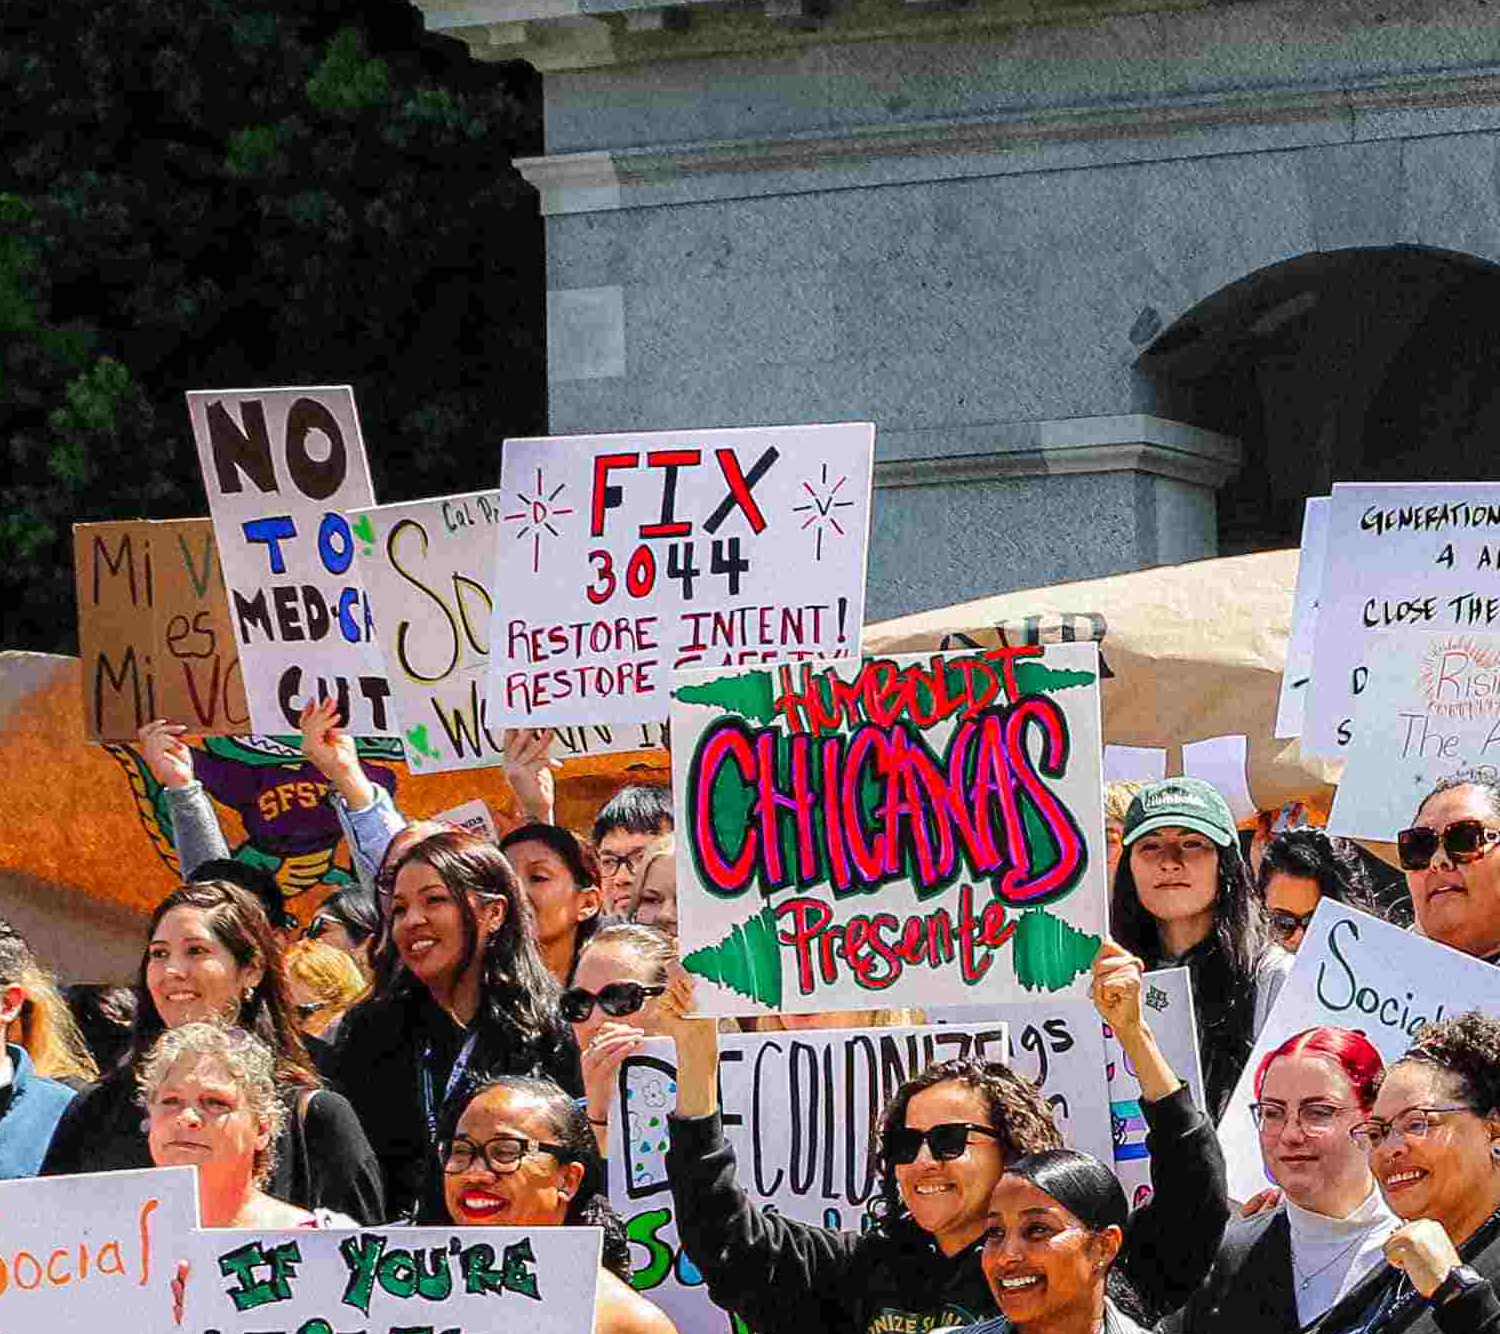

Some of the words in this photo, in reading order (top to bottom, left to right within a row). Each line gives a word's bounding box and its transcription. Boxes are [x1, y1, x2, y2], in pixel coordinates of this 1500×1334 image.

[204, 398, 348, 500] NO
[591, 445, 779, 538] FIX
[93, 535, 154, 607] Mi
[241, 511, 355, 575] TO
[587, 537, 749, 604] 3044
[1436, 544, 1453, 569] 4
[165, 611, 217, 659] es
[507, 616, 658, 663] RESTORE
[678, 597, 847, 652] INTENT!
[1364, 596, 1436, 627] CLOSE
[1449, 592, 1499, 624] THE
[94, 644, 156, 729] Mi
[277, 664, 390, 731] CUT
[506, 660, 657, 714] RESTORE
[774, 646, 1043, 736] HUMBOLDT
[1400, 713, 1459, 758] The
[688, 695, 1088, 908] CHICANAS
[776, 884, 1016, 995] Presente
[218, 1240, 302, 1312] IF
[340, 1233, 543, 1318] YOU'RE
